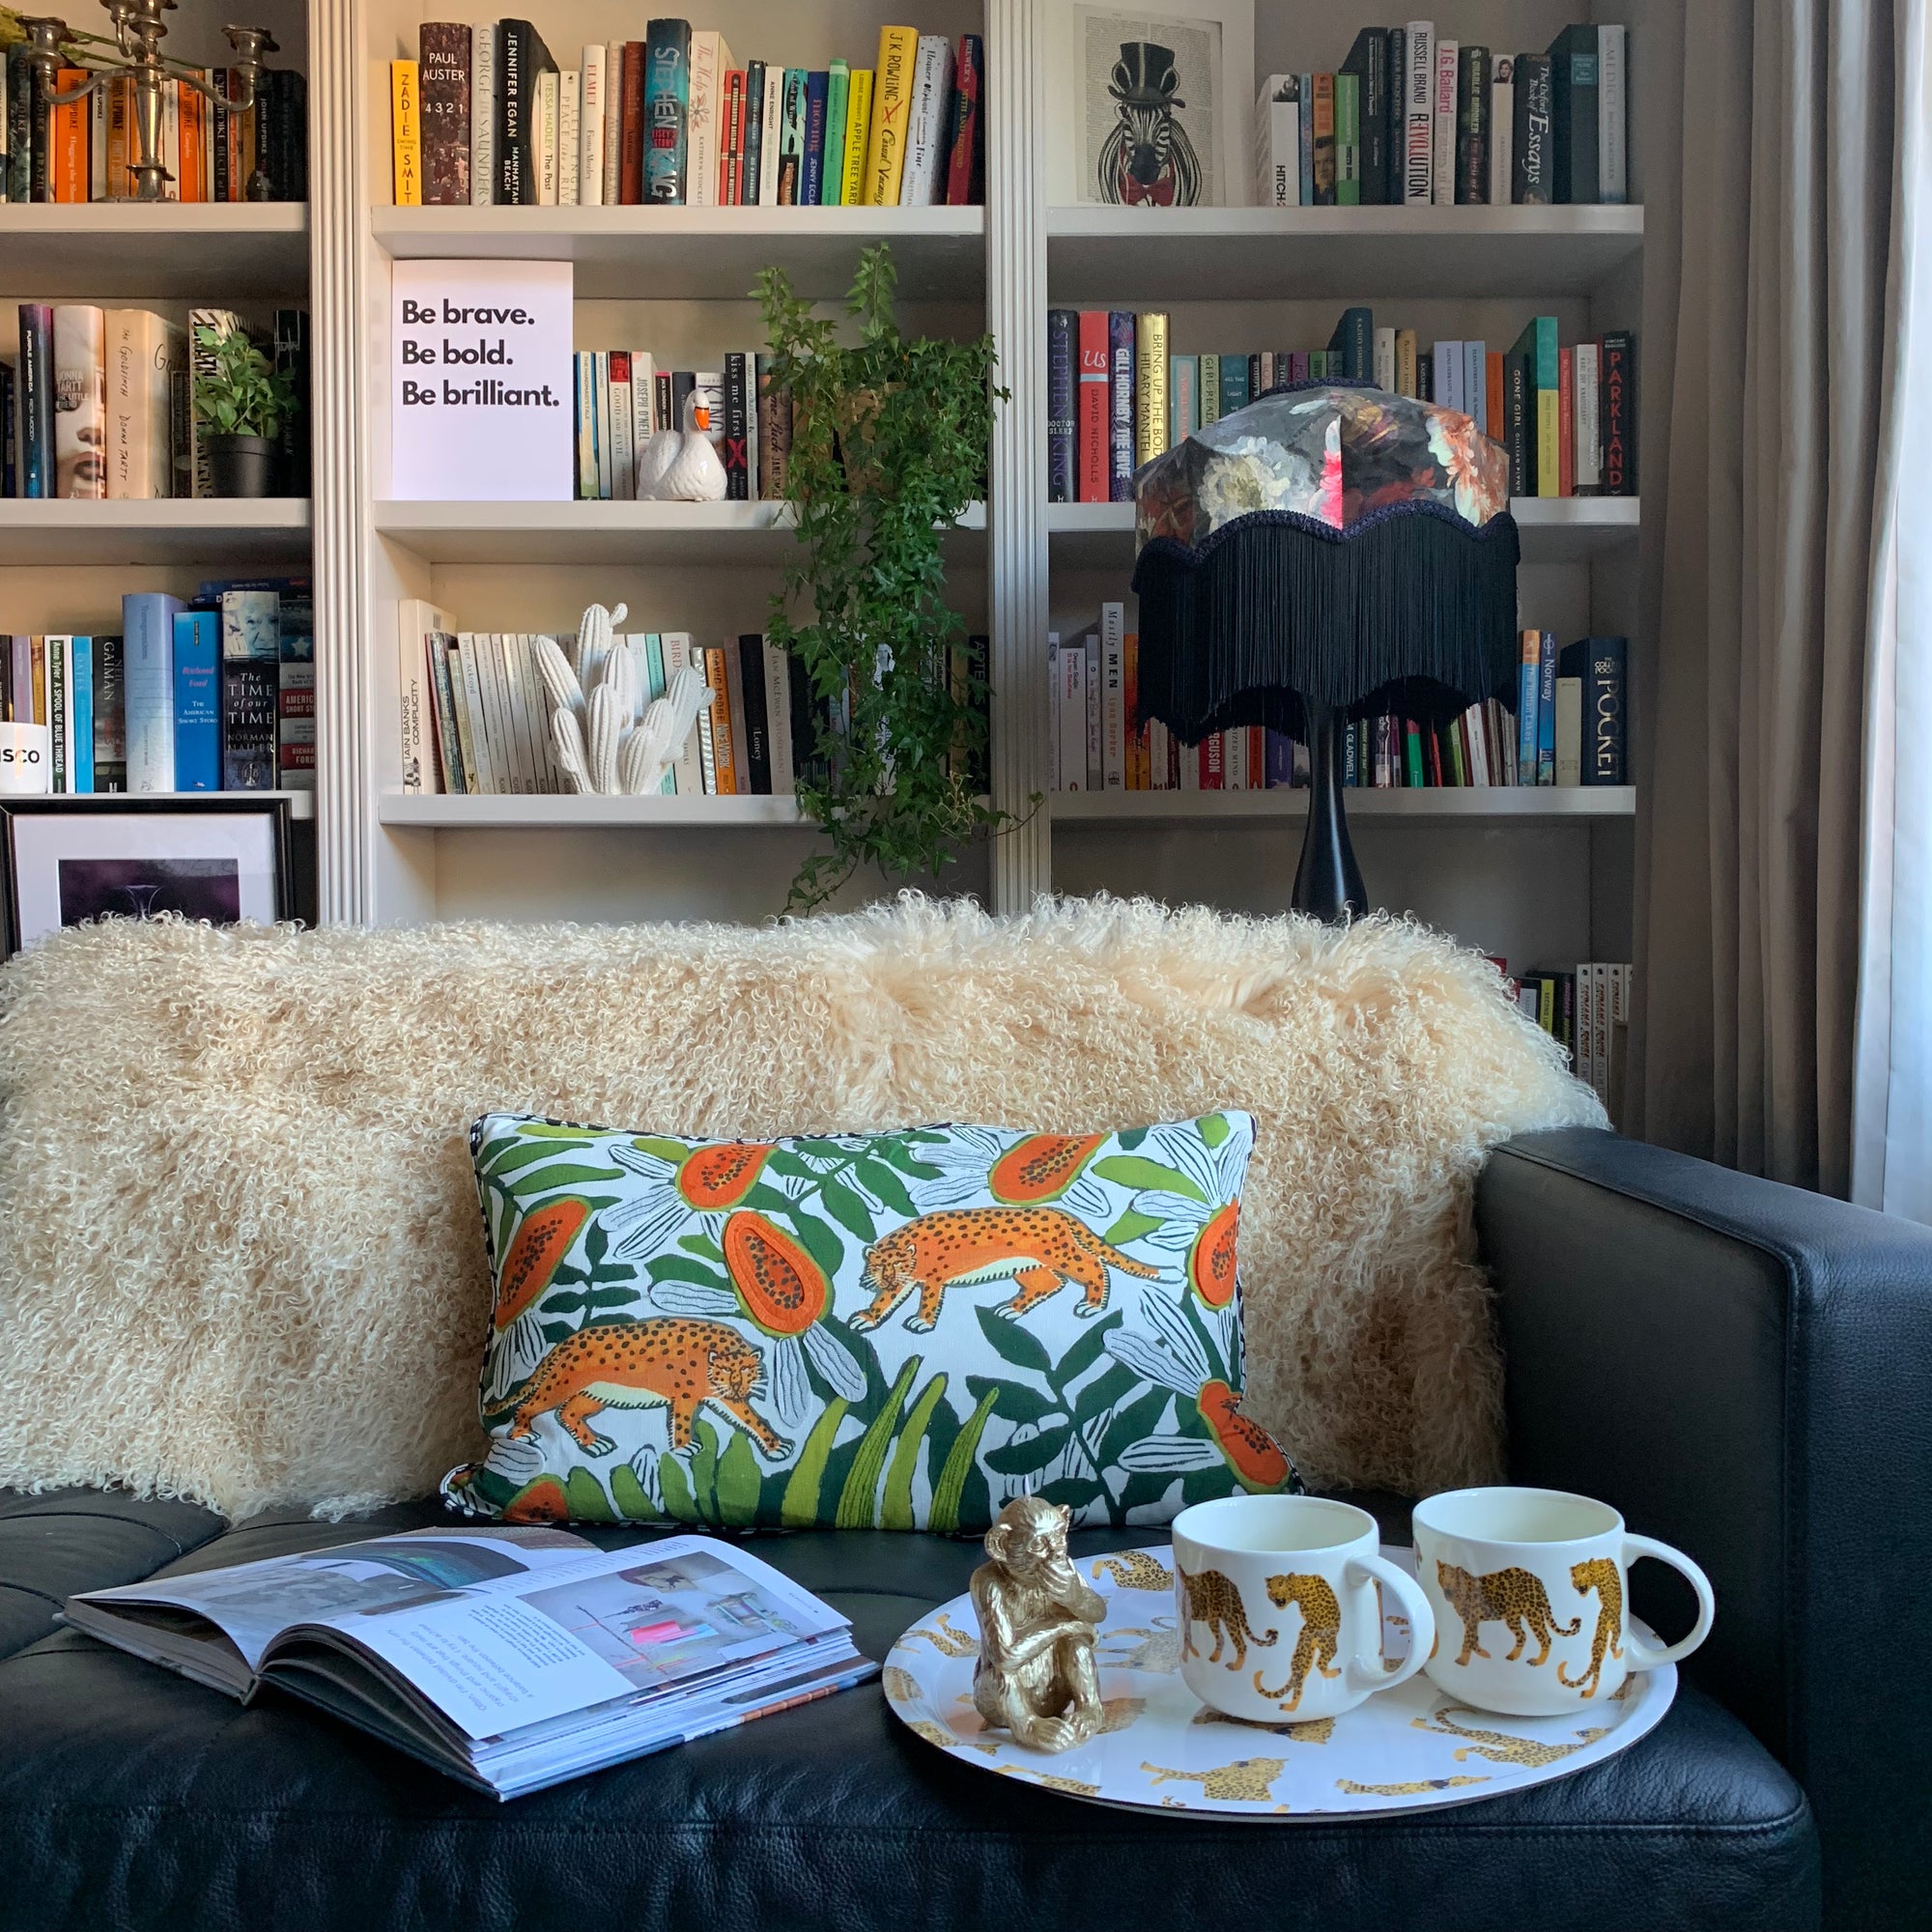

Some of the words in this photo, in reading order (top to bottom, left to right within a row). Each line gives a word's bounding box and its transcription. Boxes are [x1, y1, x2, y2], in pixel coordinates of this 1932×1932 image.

[429, 53, 458, 65] PAUL
[478, 28, 491, 96] GEORGE
[507, 32, 518, 97] JENNIFER
[696, 43, 714, 61] The
[924, 50, 936, 81] Eleanor
[962, 38, 974, 82] BREWER'S
[1413, 32, 1428, 71] RUSSELL
[1439, 48, 1455, 68] J.G.
[423, 70, 466, 82] AUSTER
[585, 64, 597, 107] ELMET
[654, 46, 680, 129] STEPHEN
[693, 66, 713, 92] Help
[1413, 73, 1428, 103] BRAND
[1471, 61, 1481, 95] CHARLIE
[1540, 67, 1549, 82] The
[545, 82, 554, 110] TESSA
[921, 83, 932, 115] Oliphant
[1439, 70, 1455, 114] Ballard
[1528, 78, 1539, 100] Book
[1537, 84, 1548, 113] Oxford
[112, 99, 125, 130] UPDIKE
[184, 100, 193, 129] UPDIKE
[425, 102, 432, 113] 4
[435, 102, 442, 113] 3
[446, 102, 454, 113] 2
[507, 100, 518, 137] EGAN
[560, 97, 570, 136] PEACE
[1470, 97, 1481, 133] BROOKER
[1526, 101, 1538, 113] of
[545, 113, 554, 150] HADLEY
[958, 113, 967, 132] AND
[585, 129, 595, 152] Fiona
[852, 122, 863, 152] APPLE
[881, 128, 895, 163] Casual
[955, 133, 966, 168] LEGEND
[1522, 113, 1549, 184] Essays
[478, 120, 491, 206] SAUNDERS
[545, 154, 554, 170] The
[696, 135, 705, 170] KATHRYN
[850, 155, 861, 178] TREE
[916, 148, 925, 169] Fine
[584, 154, 595, 180] Mozley
[650, 147, 678, 199] KING
[545, 173, 554, 190] Past
[849, 180, 860, 204] YARD
[873, 165, 893, 206] Vacancy
[402, 299, 436, 325] Be
[443, 298, 535, 326] brave.
[402, 340, 436, 365] Be
[443, 339, 514, 365] bold.
[1083, 350, 1107, 369] Us
[1116, 348, 1130, 373] GILL
[1152, 333, 1163, 374] BRING
[118, 346, 133, 398] GOLDFINCH
[730, 355, 741, 380] kiss
[1053, 331, 1068, 417] STEPHEN
[1140, 353, 1151, 398] HILARY
[57, 381, 82, 392] TARTT
[68, 392, 89, 402] LITTLE
[402, 381, 436, 406] Be
[443, 380, 560, 407] brilliant.
[636, 377, 648, 407] JOSEPH
[731, 385, 741, 404] me
[1116, 374, 1130, 423] HORNBY
[1152, 379, 1163, 394] UP
[1513, 369, 1522, 400] GONE
[613, 387, 622, 414] GOOD
[1152, 403, 1163, 424] THE
[118, 414, 131, 443] DONNA
[638, 411, 651, 440] O'NEILL
[731, 410, 743, 438] first
[1140, 403, 1151, 456] MANTEL
[1513, 404, 1522, 428] GIRL
[1608, 352, 1623, 487] PARKLAND
[615, 434, 624, 457] EVIL
[1116, 428, 1130, 449] THE
[119, 449, 129, 481] TARTT
[772, 457, 781, 476] JANE
[1052, 437, 1067, 487] KING
[1116, 450, 1131, 478] HIVE
[52, 641, 62, 660] Anne
[463, 639, 472, 660] Peter
[52, 661, 63, 679] Tyler
[103, 641, 115, 701] GAIMAN
[114, 659, 123, 682] NEIL
[240, 672, 262, 682] The
[466, 663, 478, 695] Ackroyd
[1108, 653, 1118, 689] MEN
[1541, 659, 1555, 702] Norway
[54, 689, 63, 713] SPOOL
[228, 685, 273, 696] TIME
[233, 698, 248, 709] of
[250, 699, 269, 708] our
[55, 714, 64, 724] OF
[228, 712, 274, 724] TIME
[402, 696, 412, 731] BANKS
[411, 678, 420, 746] COMPLICITY
[55, 724, 64, 743] BLUE
[227, 733, 273, 743] NORMAN
[717, 724, 728, 743] NICE
[1108, 723, 1118, 757] Barber
[1596, 679, 1620, 781] POCKET
[55, 744, 64, 773] THREAD
[227, 743, 274, 753] MAILER
[402, 736, 412, 760] IAIN
[718, 743, 731, 769] WORK
[752, 730, 762, 761] Loney
[774, 721, 785, 774] ATONEMENT
[1346, 733, 1354, 780] GLADWELL
